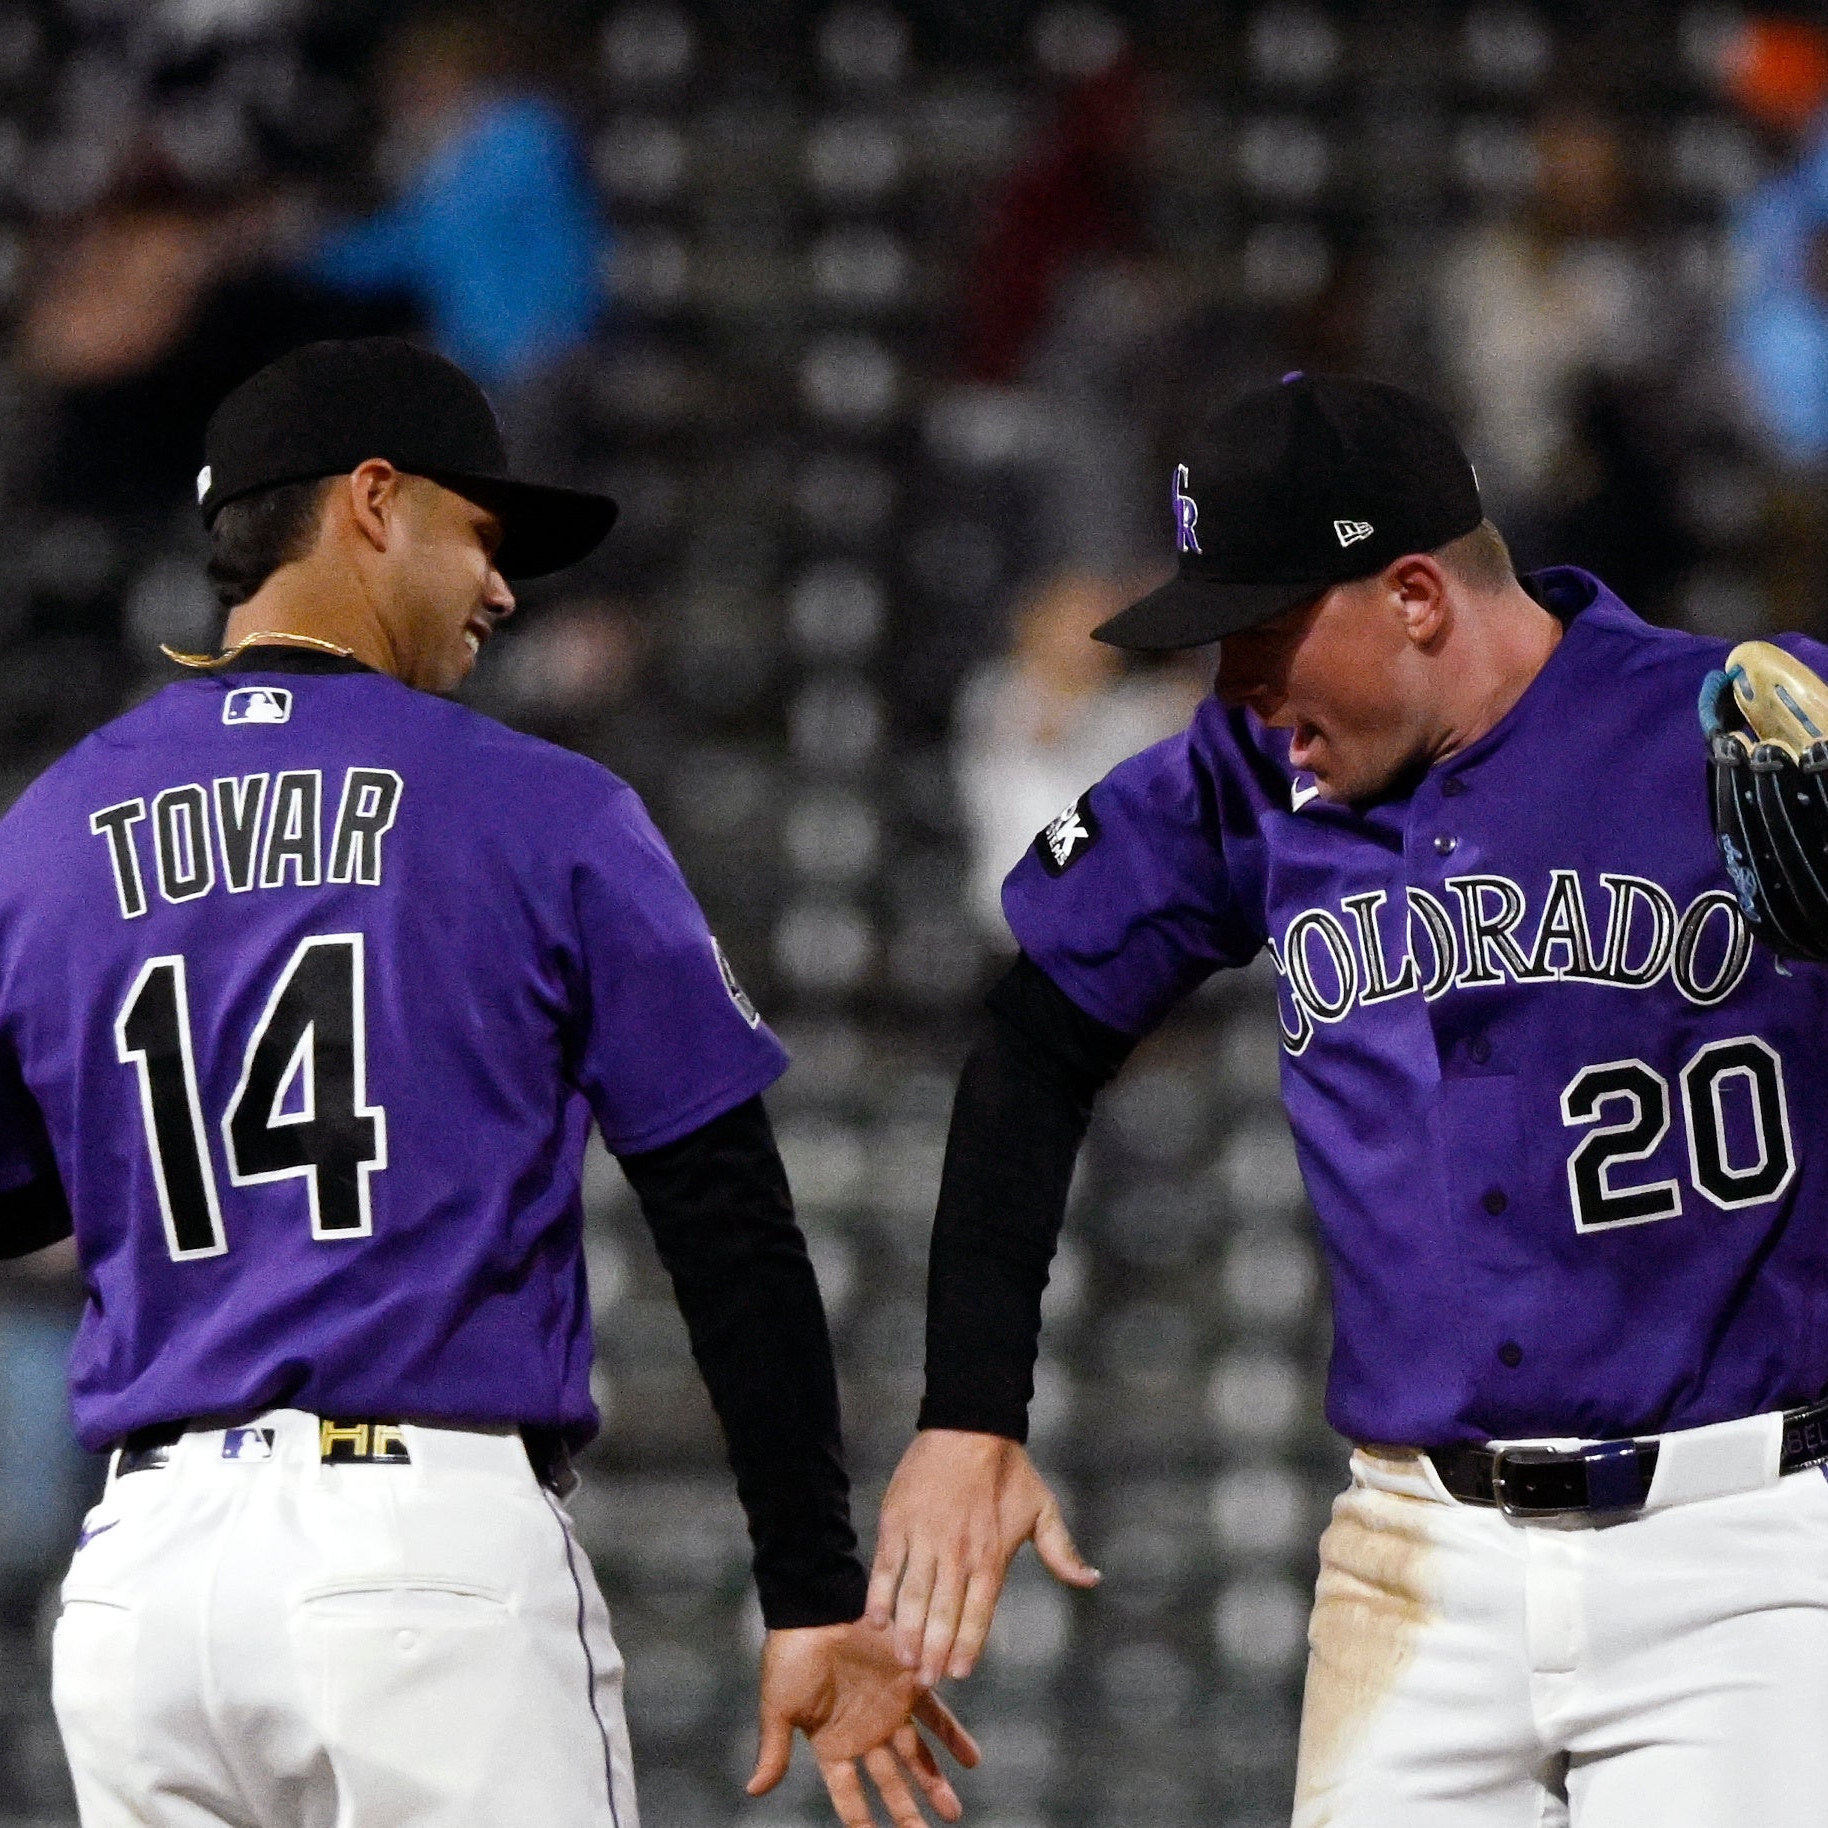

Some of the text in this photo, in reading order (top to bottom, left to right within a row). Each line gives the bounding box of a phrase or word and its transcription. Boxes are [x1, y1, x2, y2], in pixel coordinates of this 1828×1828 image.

[89, 767, 404, 920] TOVAR
[114, 932, 389, 1262] 14
[1559, 1035, 1797, 1235] 20
